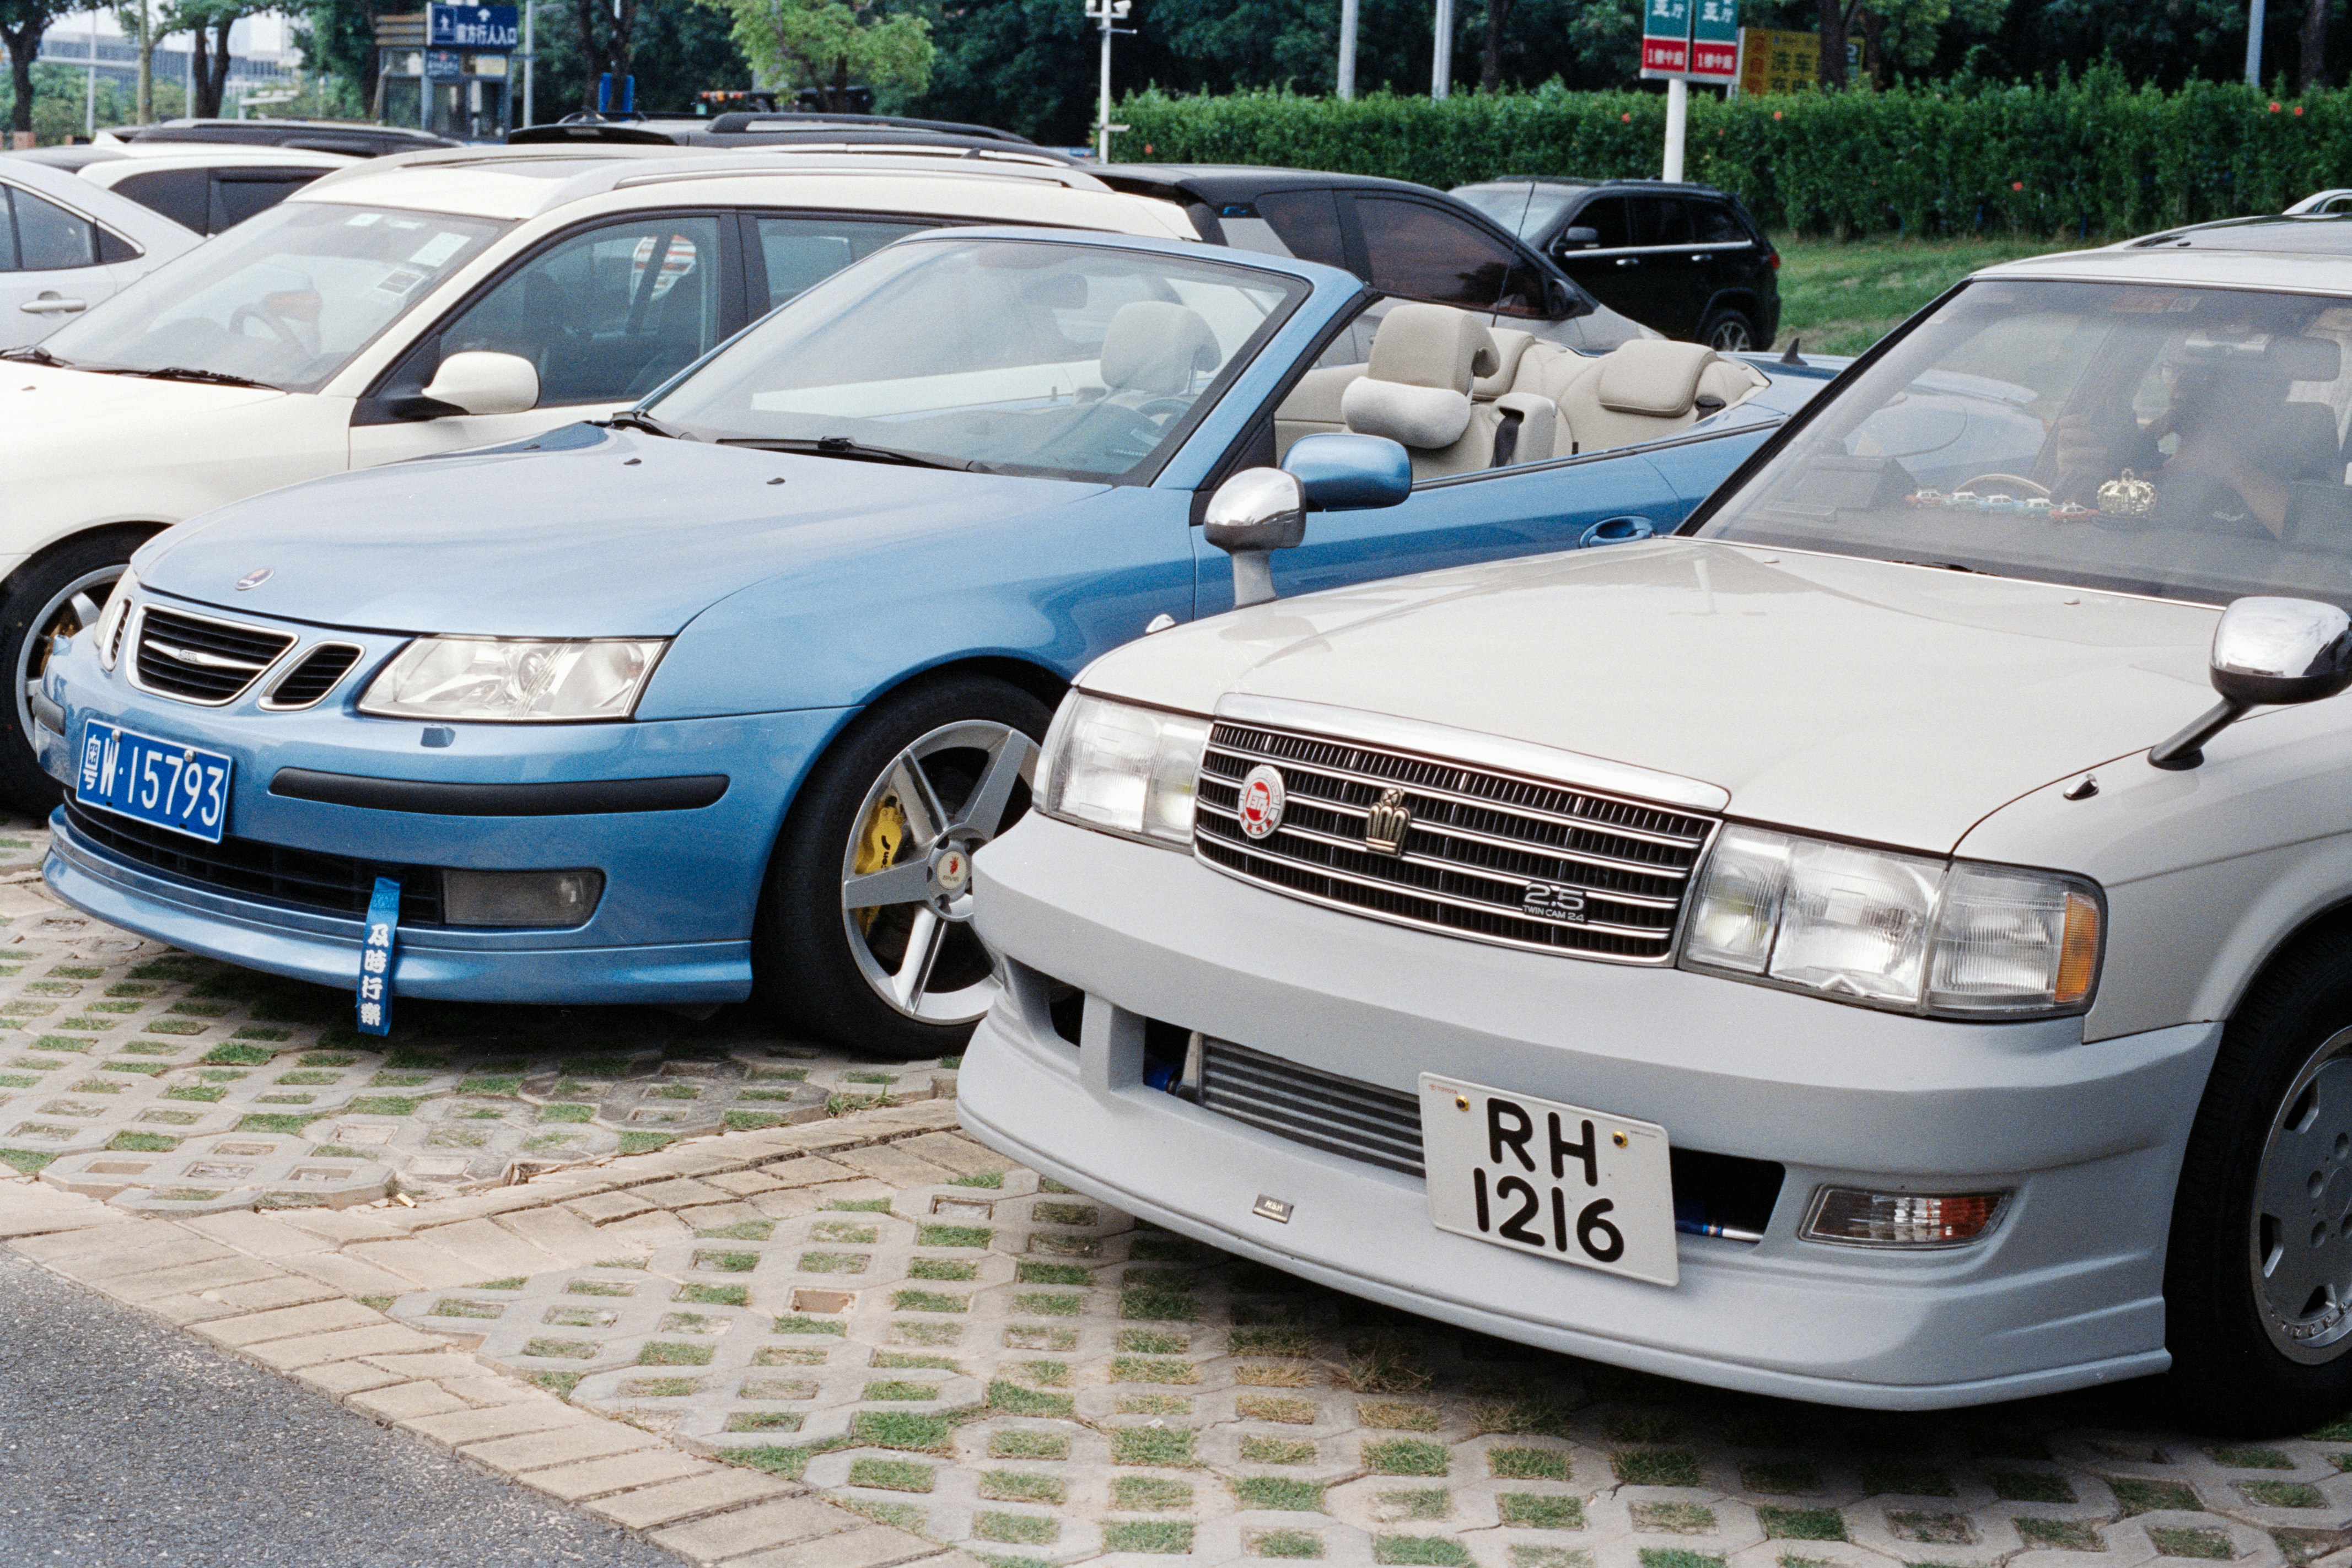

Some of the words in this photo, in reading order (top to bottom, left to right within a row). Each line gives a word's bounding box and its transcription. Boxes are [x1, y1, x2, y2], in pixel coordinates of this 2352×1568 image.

[1524, 883, 1585, 910] 2.5
[1522, 904, 1544, 916] TWIN
[1545, 909, 1566, 919] CAM
[1567, 912, 1585, 922] 24
[1437, 1086, 1458, 1095] TOYOTA
[1487, 1097, 1599, 1187] RH
[1473, 1167, 1624, 1263] 1216
